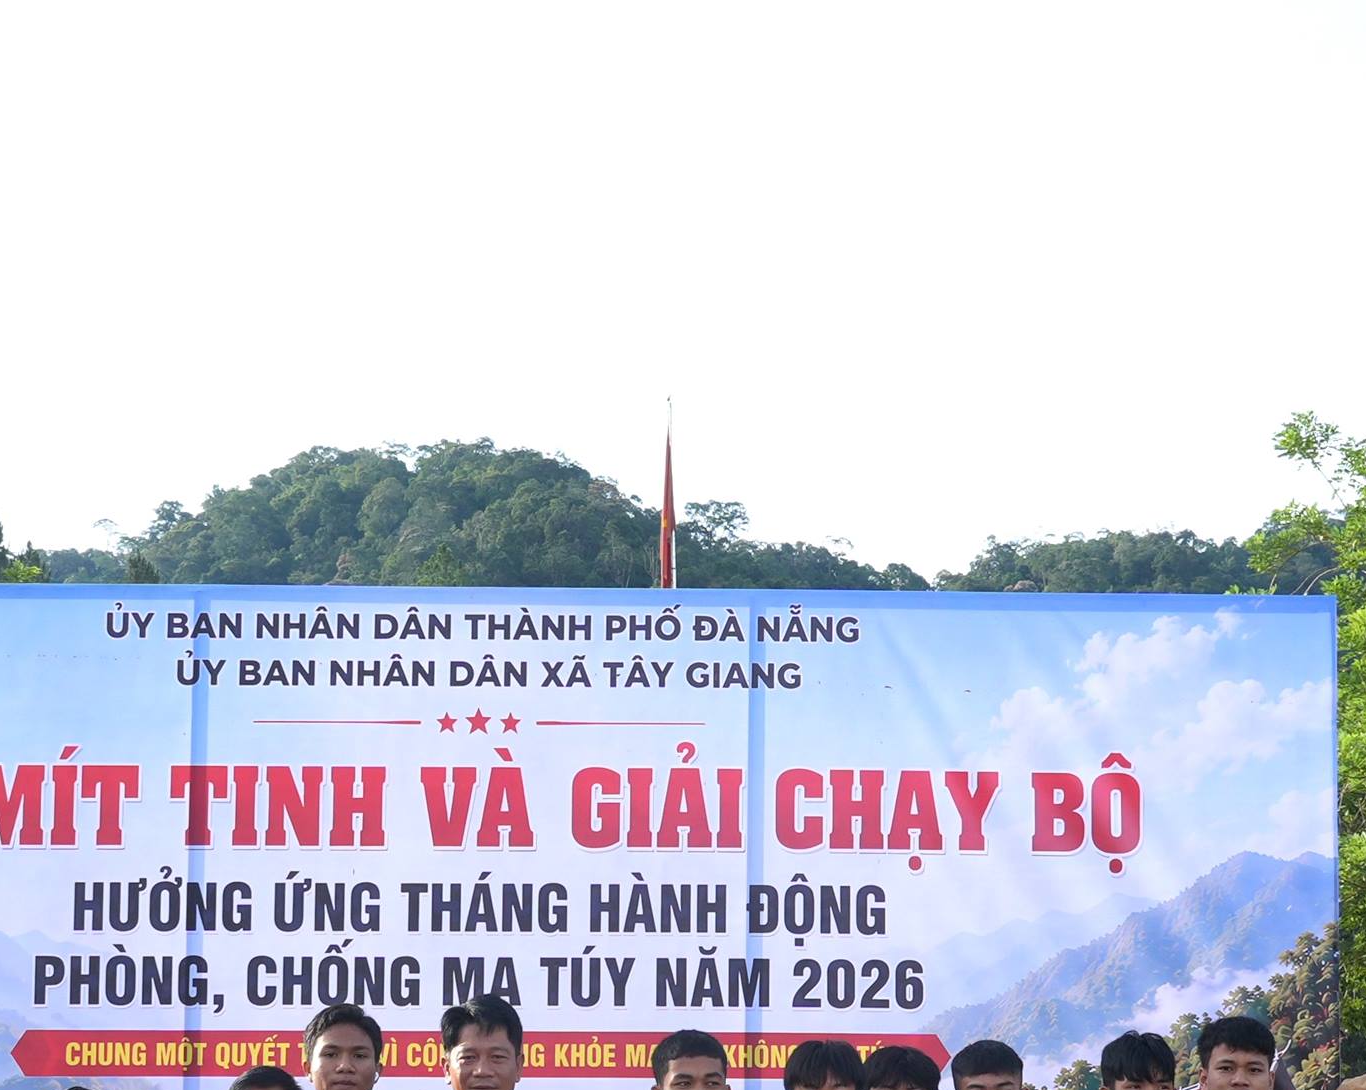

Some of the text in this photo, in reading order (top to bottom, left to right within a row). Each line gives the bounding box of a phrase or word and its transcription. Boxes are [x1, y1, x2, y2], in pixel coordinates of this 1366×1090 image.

[107, 603, 860, 643] ỦY BAN NHÂN DÂN THÀNH PHỐ ĐÀ NẴNG
[177, 650, 802, 689] ỦY BAN NHÂN DÂN XÃ TÂY GIANG
[170, 765, 387, 848] TINH
[420, 747, 535, 848] VÀ
[572, 741, 745, 850] GIẢI
[775, 767, 1001, 872] CHẠY
[1032, 753, 1142, 872] BỘ
[73, 866, 887, 947] HƯỞNG ỨNG THÁNG HÀNH ĐỘNG
[34, 939, 925, 1014] PHÒNG, CHỐNG MA TÚY NĂM 2026
[65, 1042, 146, 1066] CHUNG
[156, 1036, 207, 1071] MỘT
[215, 1034, 290, 1068] QUYẾT
[406, 1037, 444, 1072] CỘ
[554, 1036, 617, 1068] KHỎE
